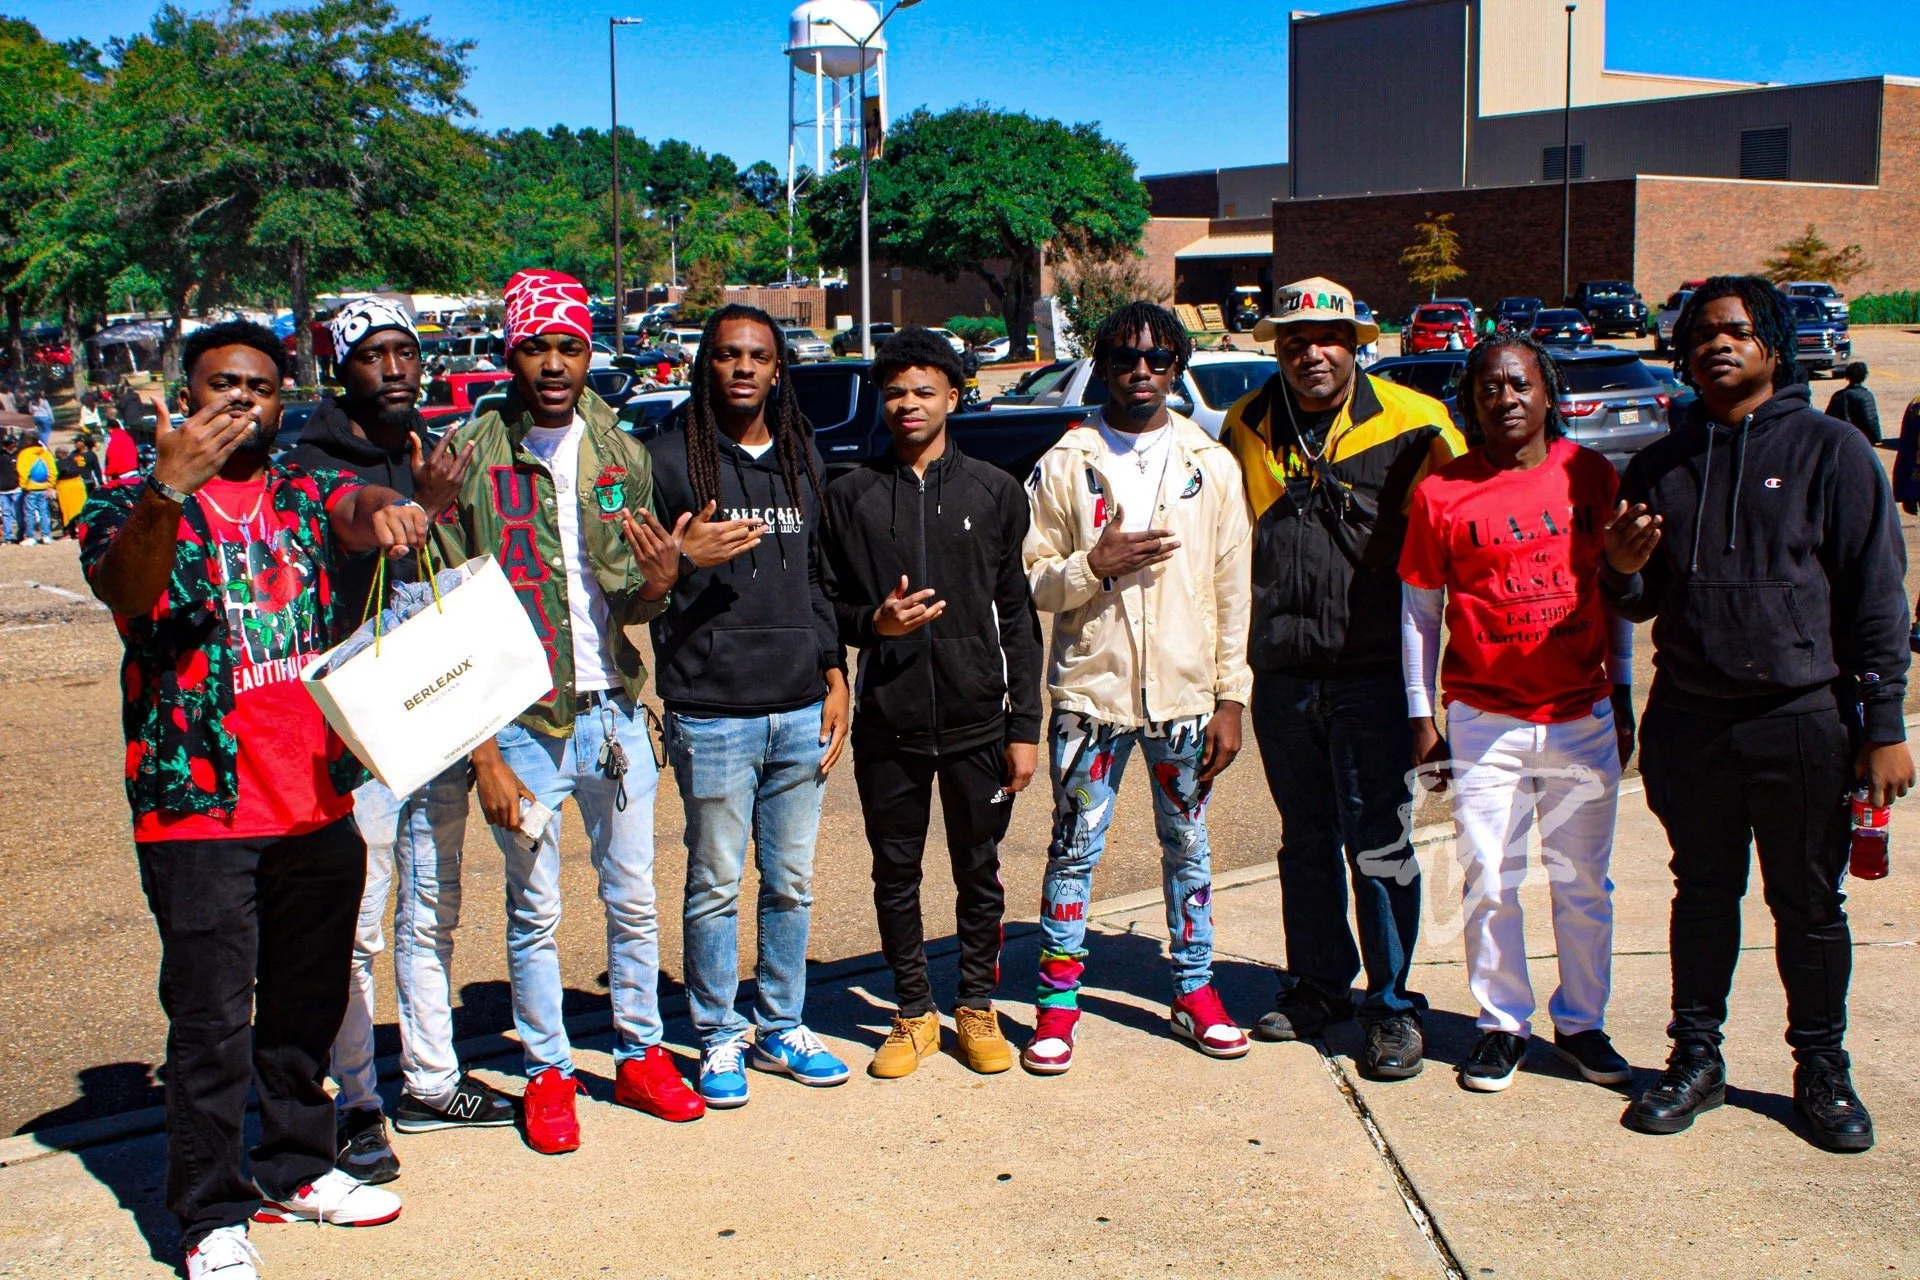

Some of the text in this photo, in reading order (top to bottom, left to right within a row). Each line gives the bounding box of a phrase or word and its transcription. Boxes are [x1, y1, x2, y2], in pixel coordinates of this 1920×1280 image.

[1288, 291, 1344, 313] UAAM
[1506, 610, 1537, 626] Est.
[1477, 628, 1544, 644] Charter
[403, 658, 473, 711] BERLEAUX
[447, 1092, 482, 1119] N
